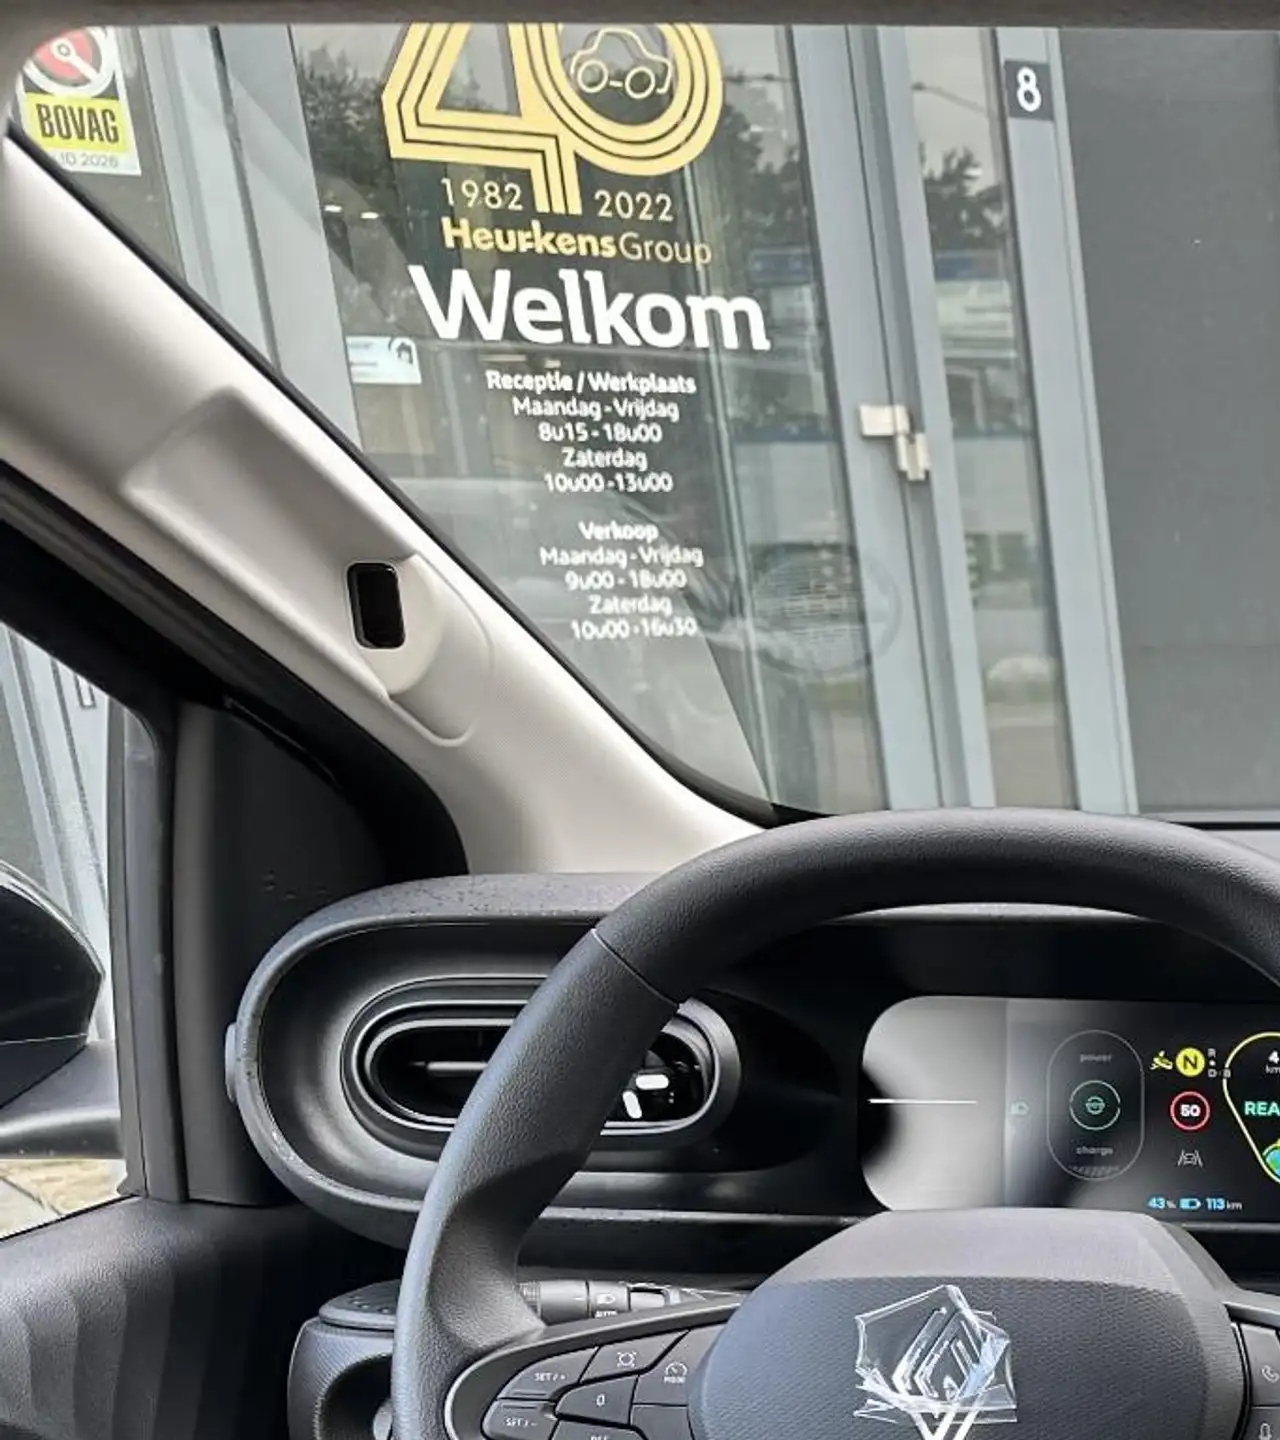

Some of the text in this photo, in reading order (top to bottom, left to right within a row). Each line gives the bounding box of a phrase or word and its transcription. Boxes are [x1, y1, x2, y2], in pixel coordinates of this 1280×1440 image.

[1017, 66, 1042, 112] 8
[36, 103, 120, 143] BOVAG
[82, 154, 119, 168] 2026
[440, 178, 673, 222] 1982 2022
[440, 216, 712, 271] HeurkensGroup
[408, 264, 771, 351] Welkom
[485, 370, 573, 394] Receptie
[588, 371, 697, 396] Werkplaats
[512, 397, 602, 421] Maandag
[612, 398, 680, 423] Vrijdag
[538, 422, 589, 442] 8u15
[602, 422, 663, 443] 18u00
[561, 447, 648, 472] Zaterdag
[544, 473, 605, 493] 10u00
[615, 472, 674, 493] 13u00
[578, 520, 660, 543] Verkoop
[540, 546, 628, 569] Maandag
[637, 545, 705, 568] Vrijdag
[565, 570, 615, 591] 9u00
[628, 569, 688, 589] 18u00
[588, 594, 674, 616] Zaterdag
[571, 619, 630, 640] 10u00
[1182, 1055, 1199, 1071] N
[1268, 1050, 1280, 1064] 4
